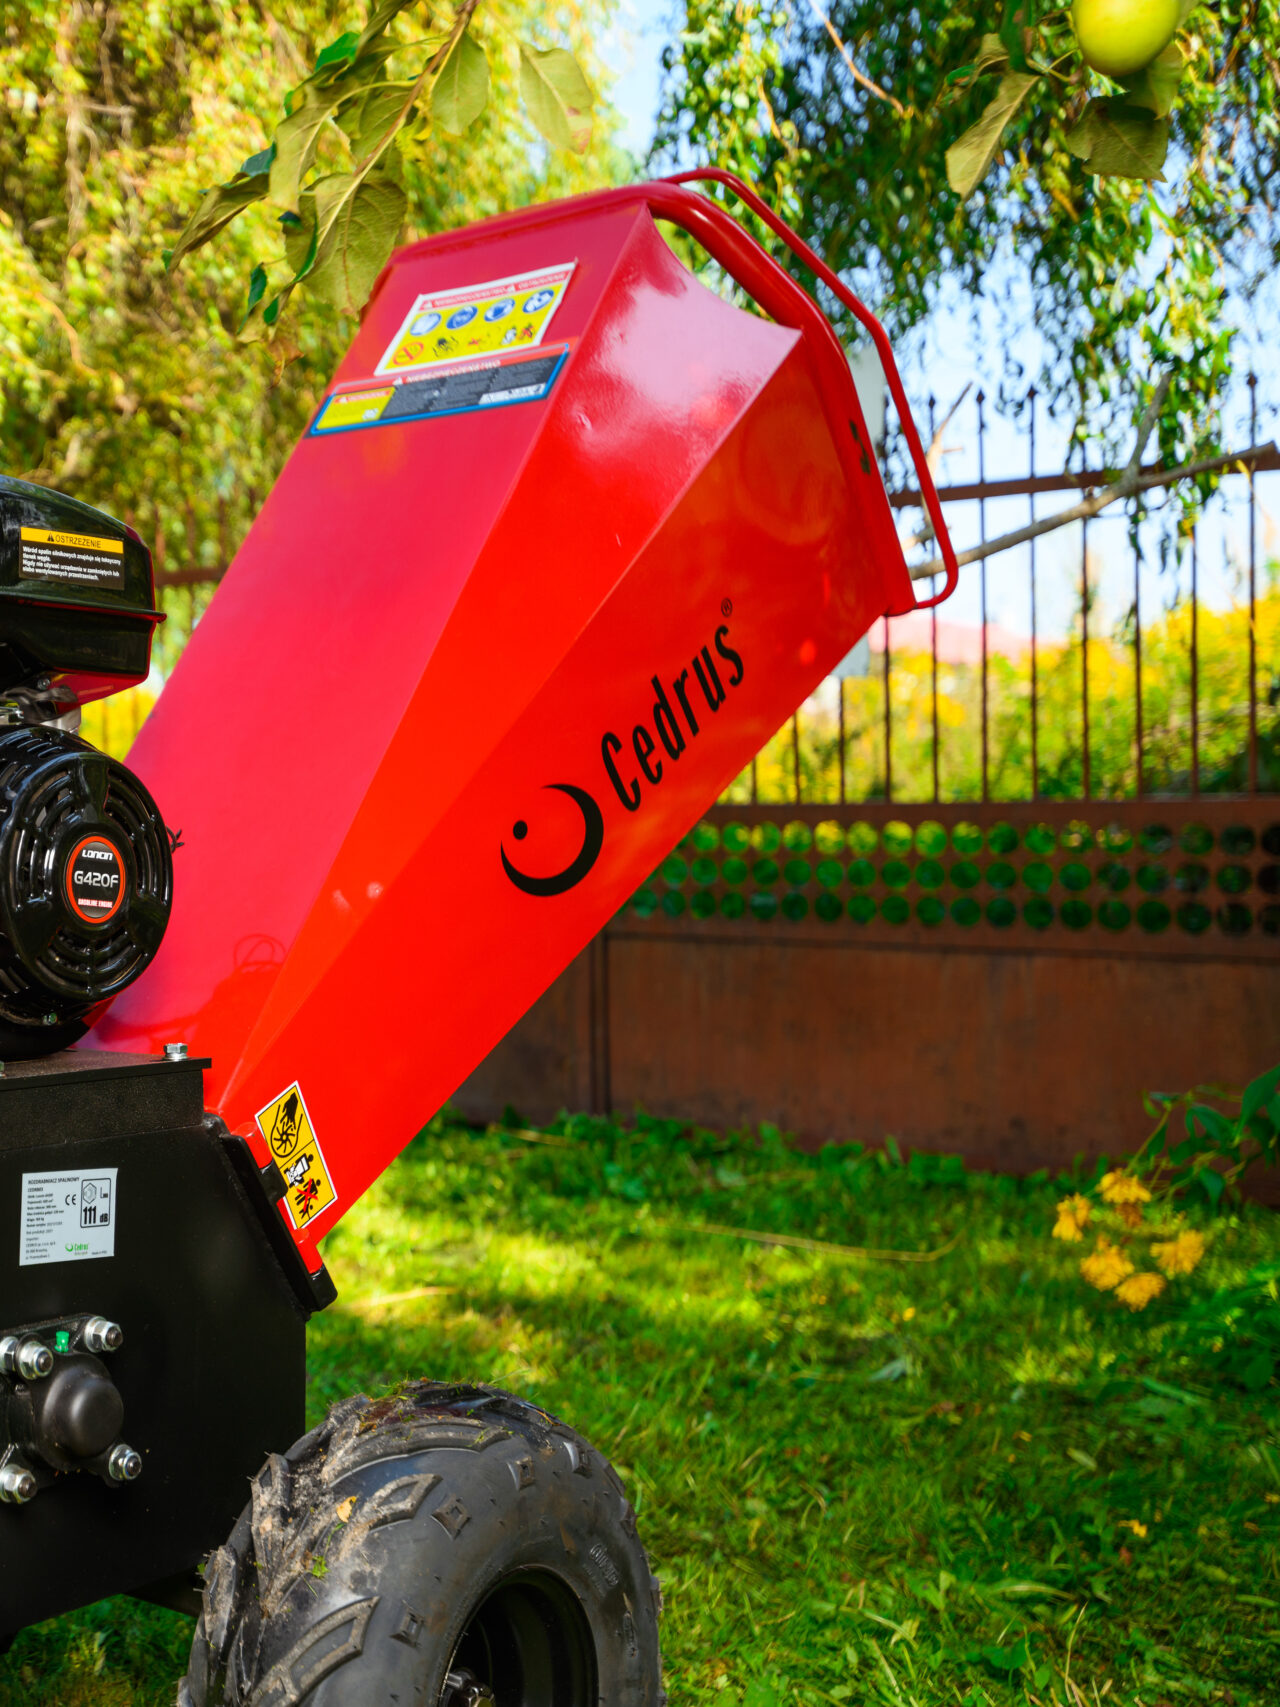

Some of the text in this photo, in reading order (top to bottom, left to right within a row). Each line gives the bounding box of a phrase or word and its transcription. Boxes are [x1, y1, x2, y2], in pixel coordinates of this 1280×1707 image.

[601, 624, 744, 812] Cedrus
[74, 871, 119, 887] G420F
[78, 898, 113, 908] GASOLINE ENGINE
[83, 1206, 108, 1224] 111 dB
